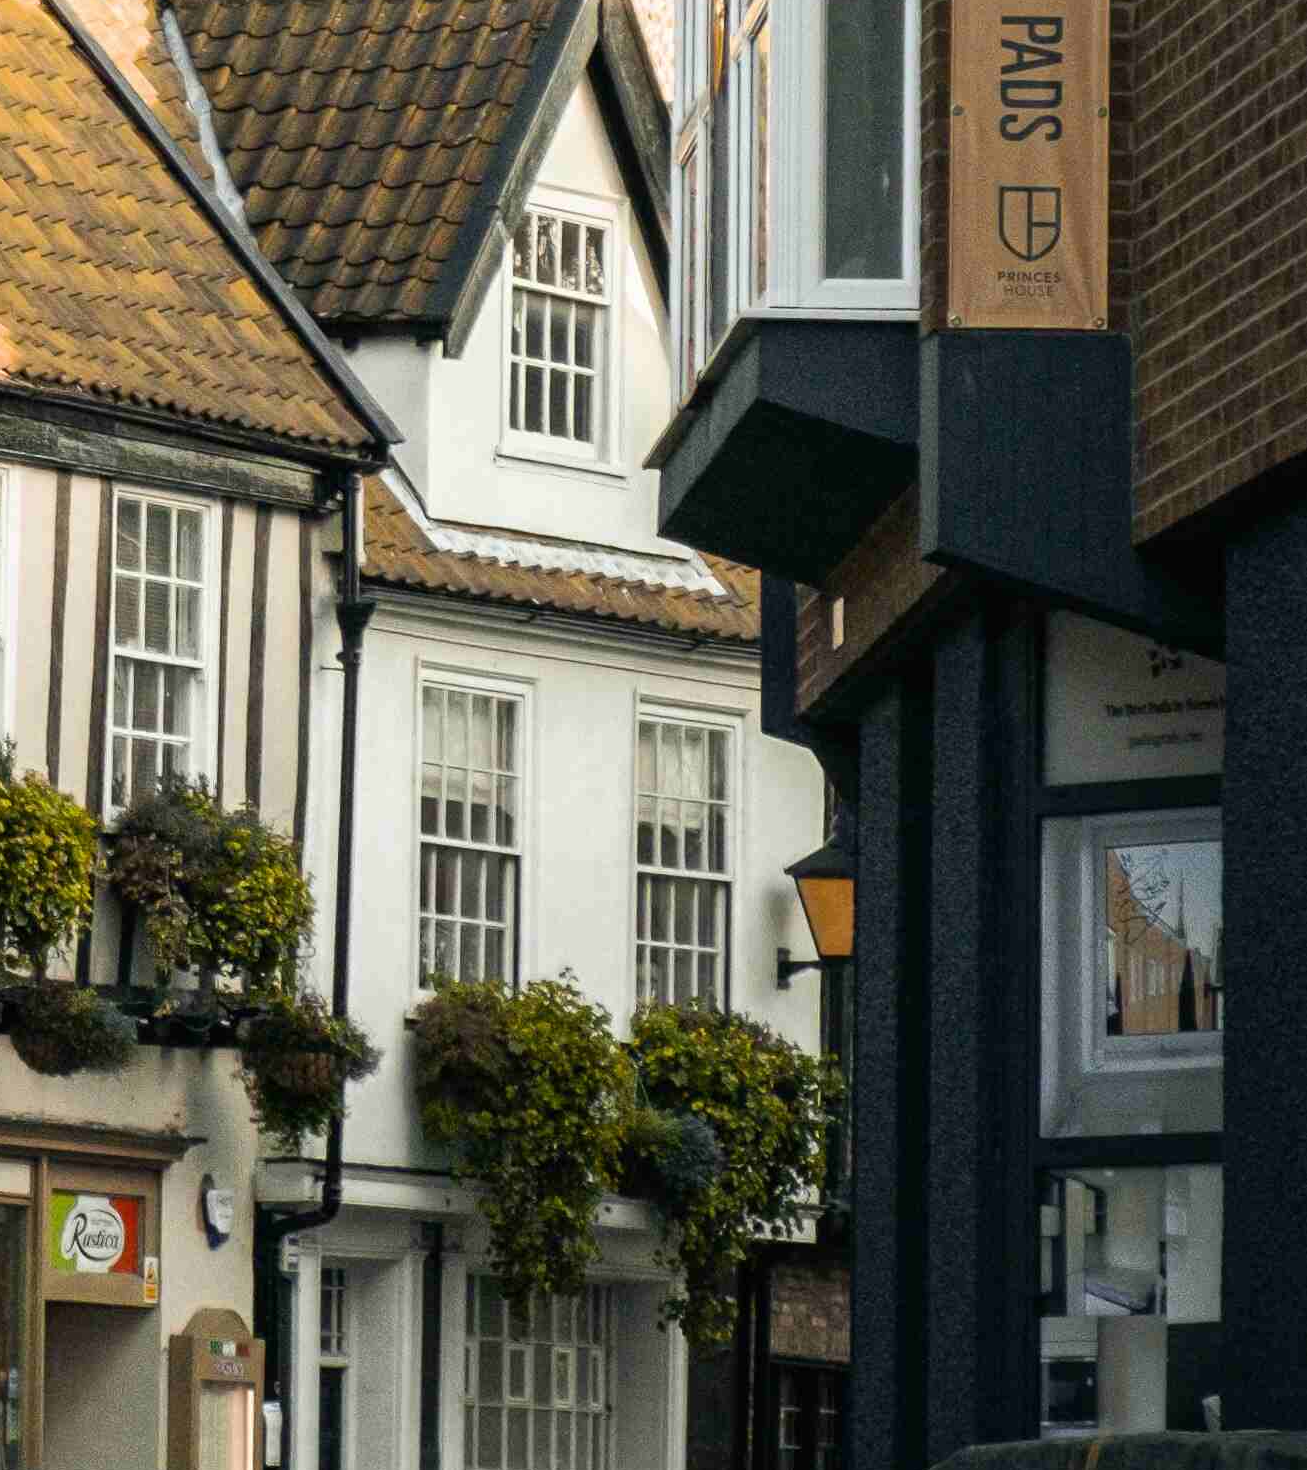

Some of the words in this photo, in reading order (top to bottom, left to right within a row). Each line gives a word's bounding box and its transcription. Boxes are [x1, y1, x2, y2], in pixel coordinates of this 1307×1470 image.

[1000, 16, 1064, 142] PADS
[997, 270, 1061, 284] PRINCES
[1003, 284, 1055, 297] HOUSE
[66, 1212, 119, 1253] Rustica
